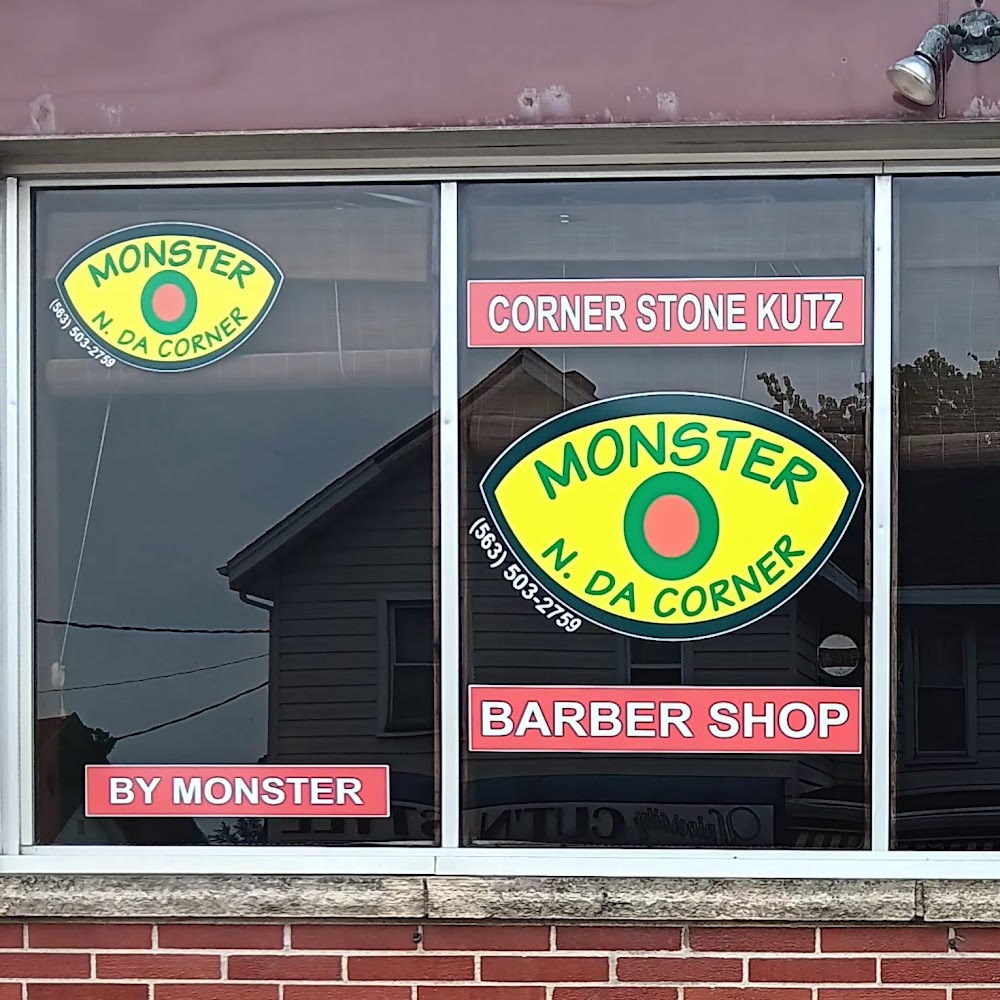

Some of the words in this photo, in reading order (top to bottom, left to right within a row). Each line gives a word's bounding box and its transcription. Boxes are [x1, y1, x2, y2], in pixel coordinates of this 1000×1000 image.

[88, 240, 256, 289] MONSTER
[49, 299, 70, 330] (563)
[69, 326, 116, 369] 503-2759
[92, 311, 113, 335] N.
[117, 329, 148, 354] DA
[158, 306, 249, 358] CORNER
[488, 294, 628, 332] CORNER
[636, 293, 746, 331] STONE
[757, 292, 845, 331] KUTZ
[534, 420, 817, 505] MONSTER
[469, 517, 508, 568] (563)
[503, 565, 583, 633] 503-2759
[541, 537, 578, 579] N.
[584, 570, 637, 613] DA
[653, 534, 806, 618] CORNER
[480, 701, 694, 739] BARBER
[708, 702, 850, 739] SHOP
[109, 777, 161, 805] BY
[173, 777, 364, 806] MONSTER
